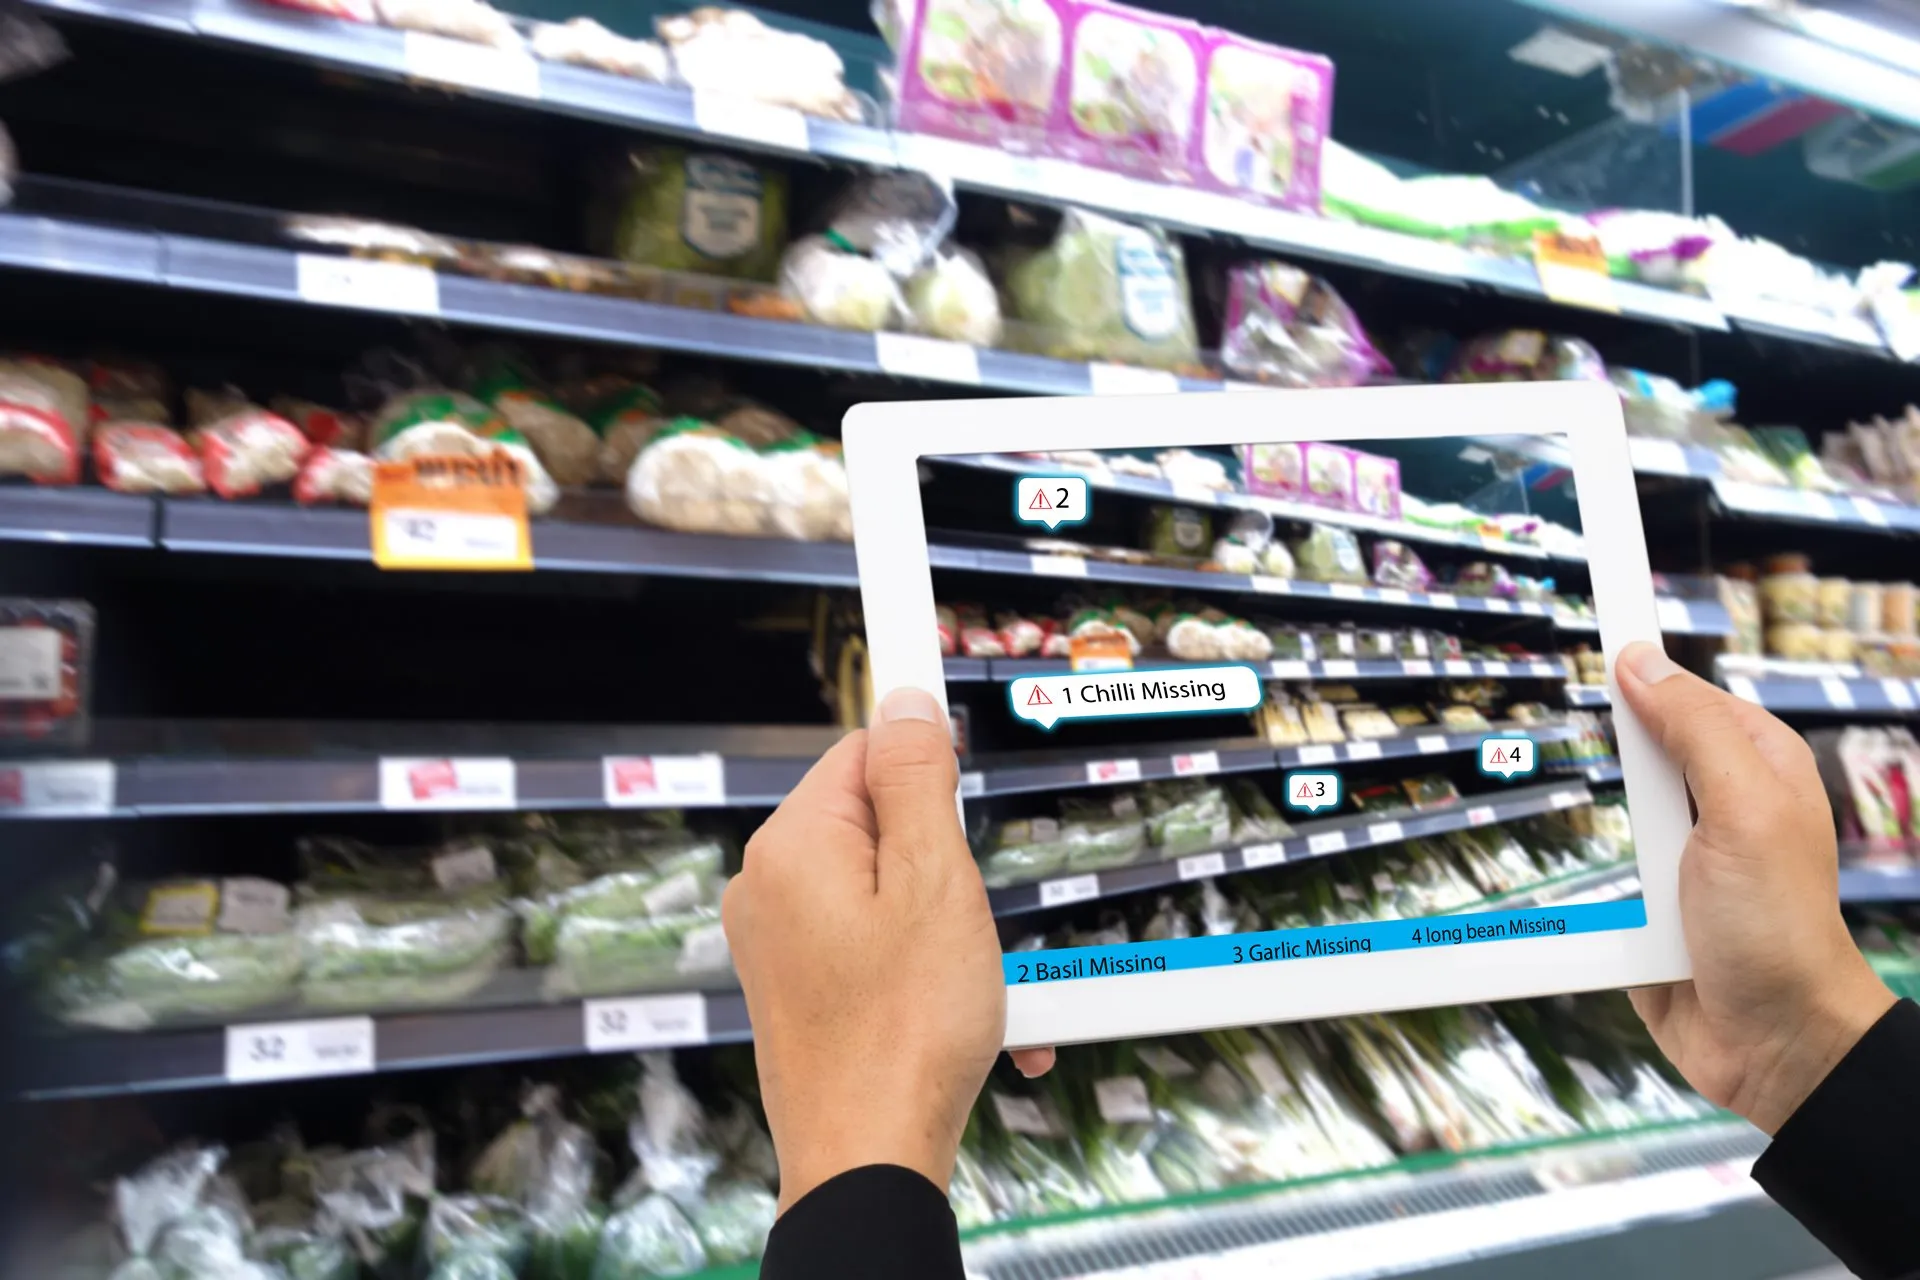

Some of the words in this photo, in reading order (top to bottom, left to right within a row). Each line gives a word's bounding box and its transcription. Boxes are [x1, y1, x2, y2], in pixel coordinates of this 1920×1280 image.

[1055, 487, 1070, 509] 2
[1062, 687, 1072, 704] 1
[1080, 682, 1136, 703] Chilli
[1141, 680, 1226, 701] Missing
[1509, 746, 1522, 763] 4
[1315, 781, 1325, 797] 3
[1411, 928, 1423, 944] 4
[1426, 926, 1463, 945] long
[1466, 923, 1506, 940] bean
[1509, 917, 1566, 935] Missing
[1232, 946, 1244, 964] 3
[1248, 941, 1301, 962] Garlic
[1305, 936, 1372, 957] Missing
[1017, 964, 1030, 983] 2
[1035, 958, 1083, 981] Basil
[1090, 954, 1166, 976] Missing
